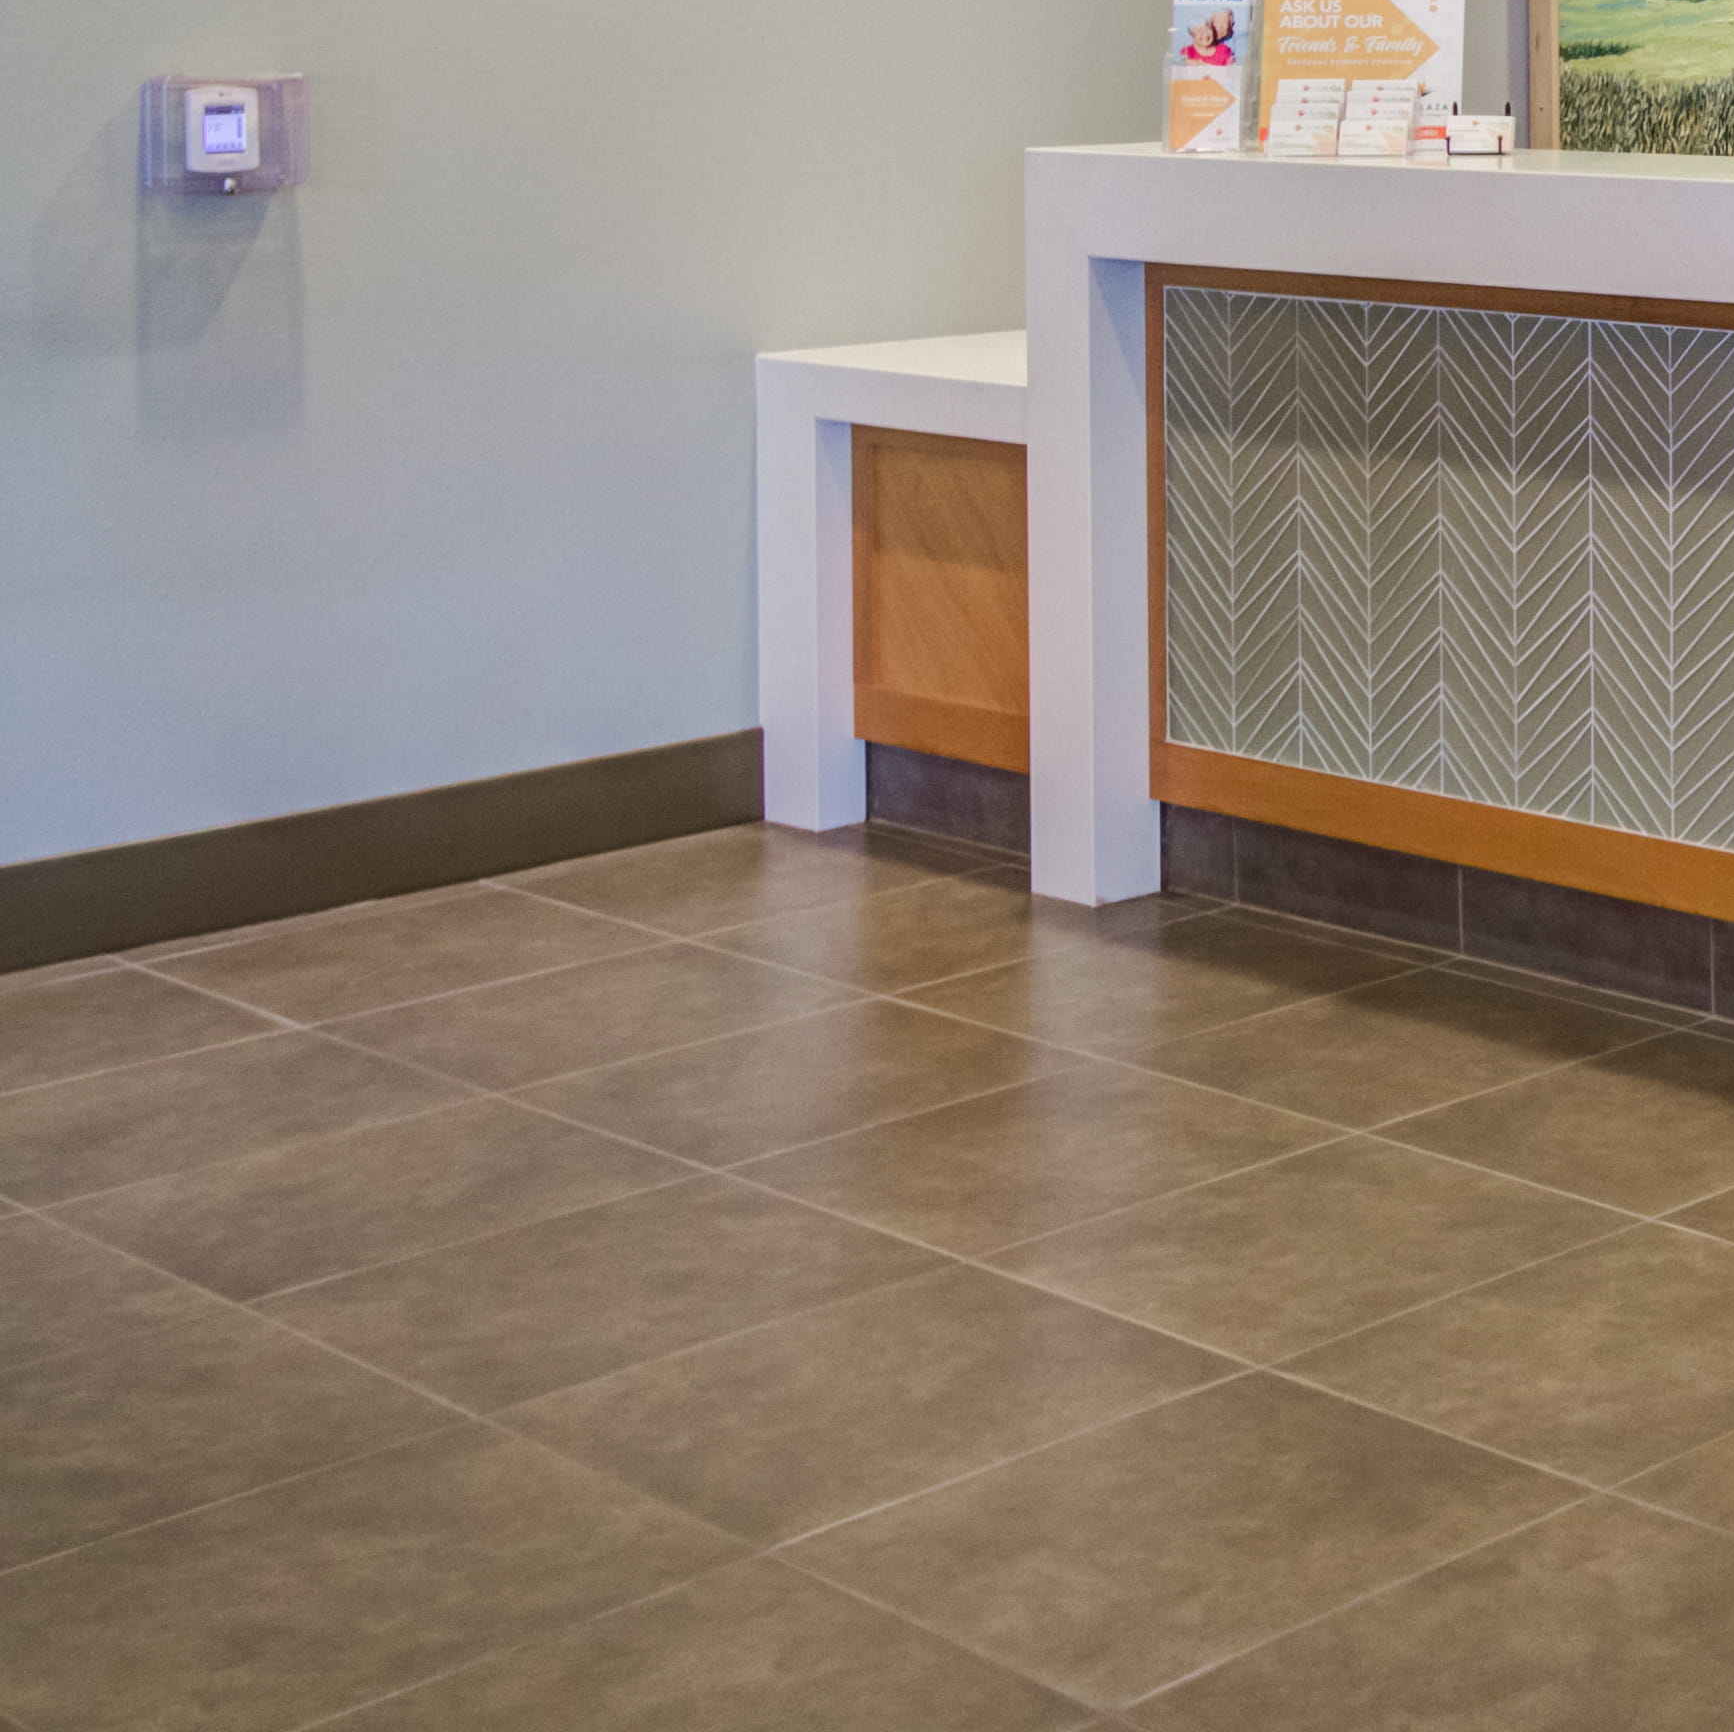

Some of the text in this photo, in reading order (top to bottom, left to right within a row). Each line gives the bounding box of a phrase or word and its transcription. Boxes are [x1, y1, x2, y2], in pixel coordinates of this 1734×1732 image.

[1280, 0, 1342, 13] ASK US
[1279, 15, 1383, 28] ABOUT OUR
[1278, 35, 1337, 54] Friends
[1364, 35, 1424, 57] Family
